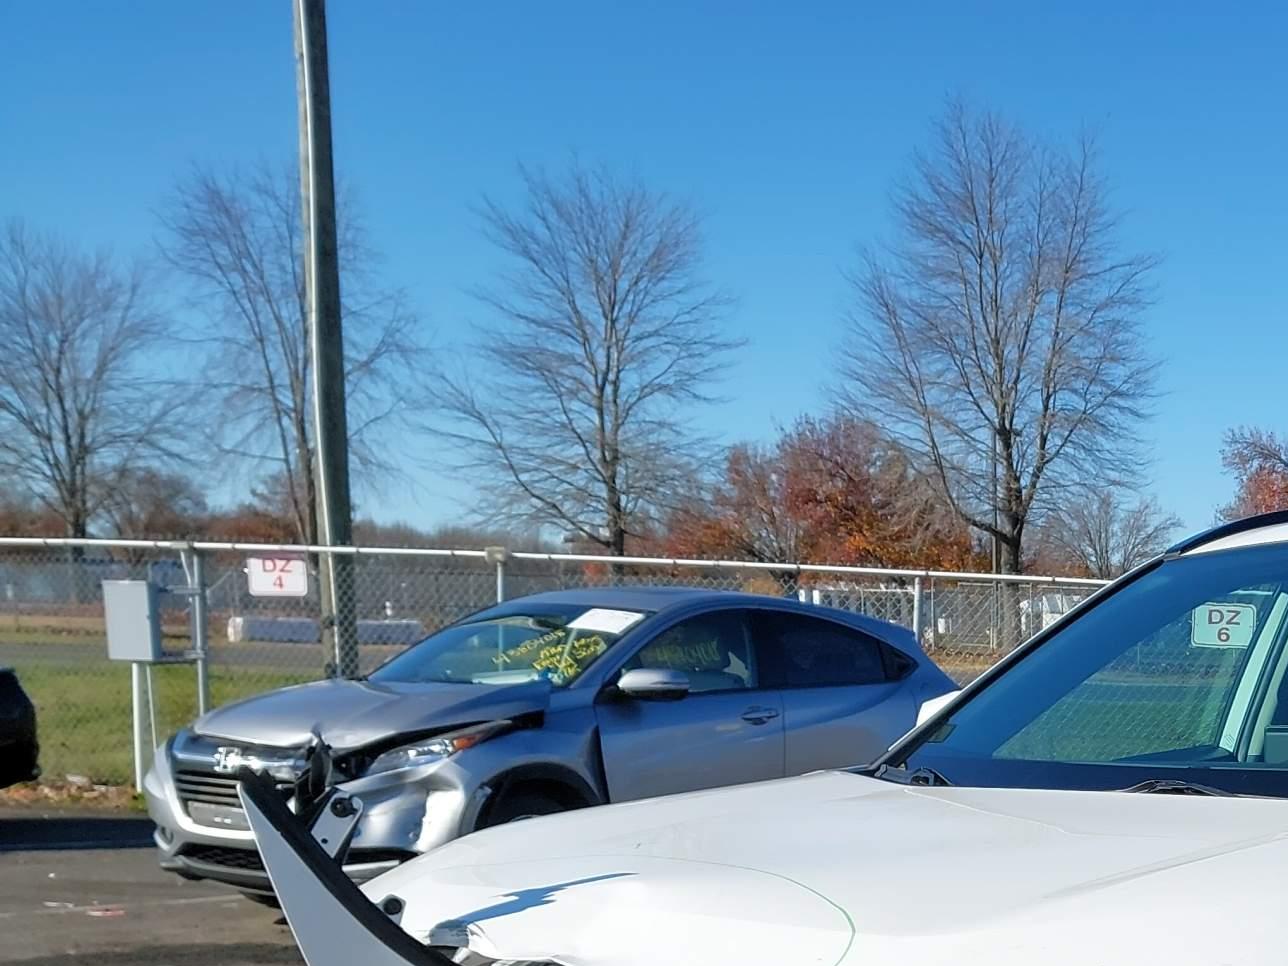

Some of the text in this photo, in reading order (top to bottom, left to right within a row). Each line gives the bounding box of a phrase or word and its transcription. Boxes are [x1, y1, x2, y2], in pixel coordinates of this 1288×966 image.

[262, 557, 293, 573] DZ
[273, 575, 284, 589] 4
[1207, 608, 1241, 626] DZ
[1217, 627, 1230, 643] 6
